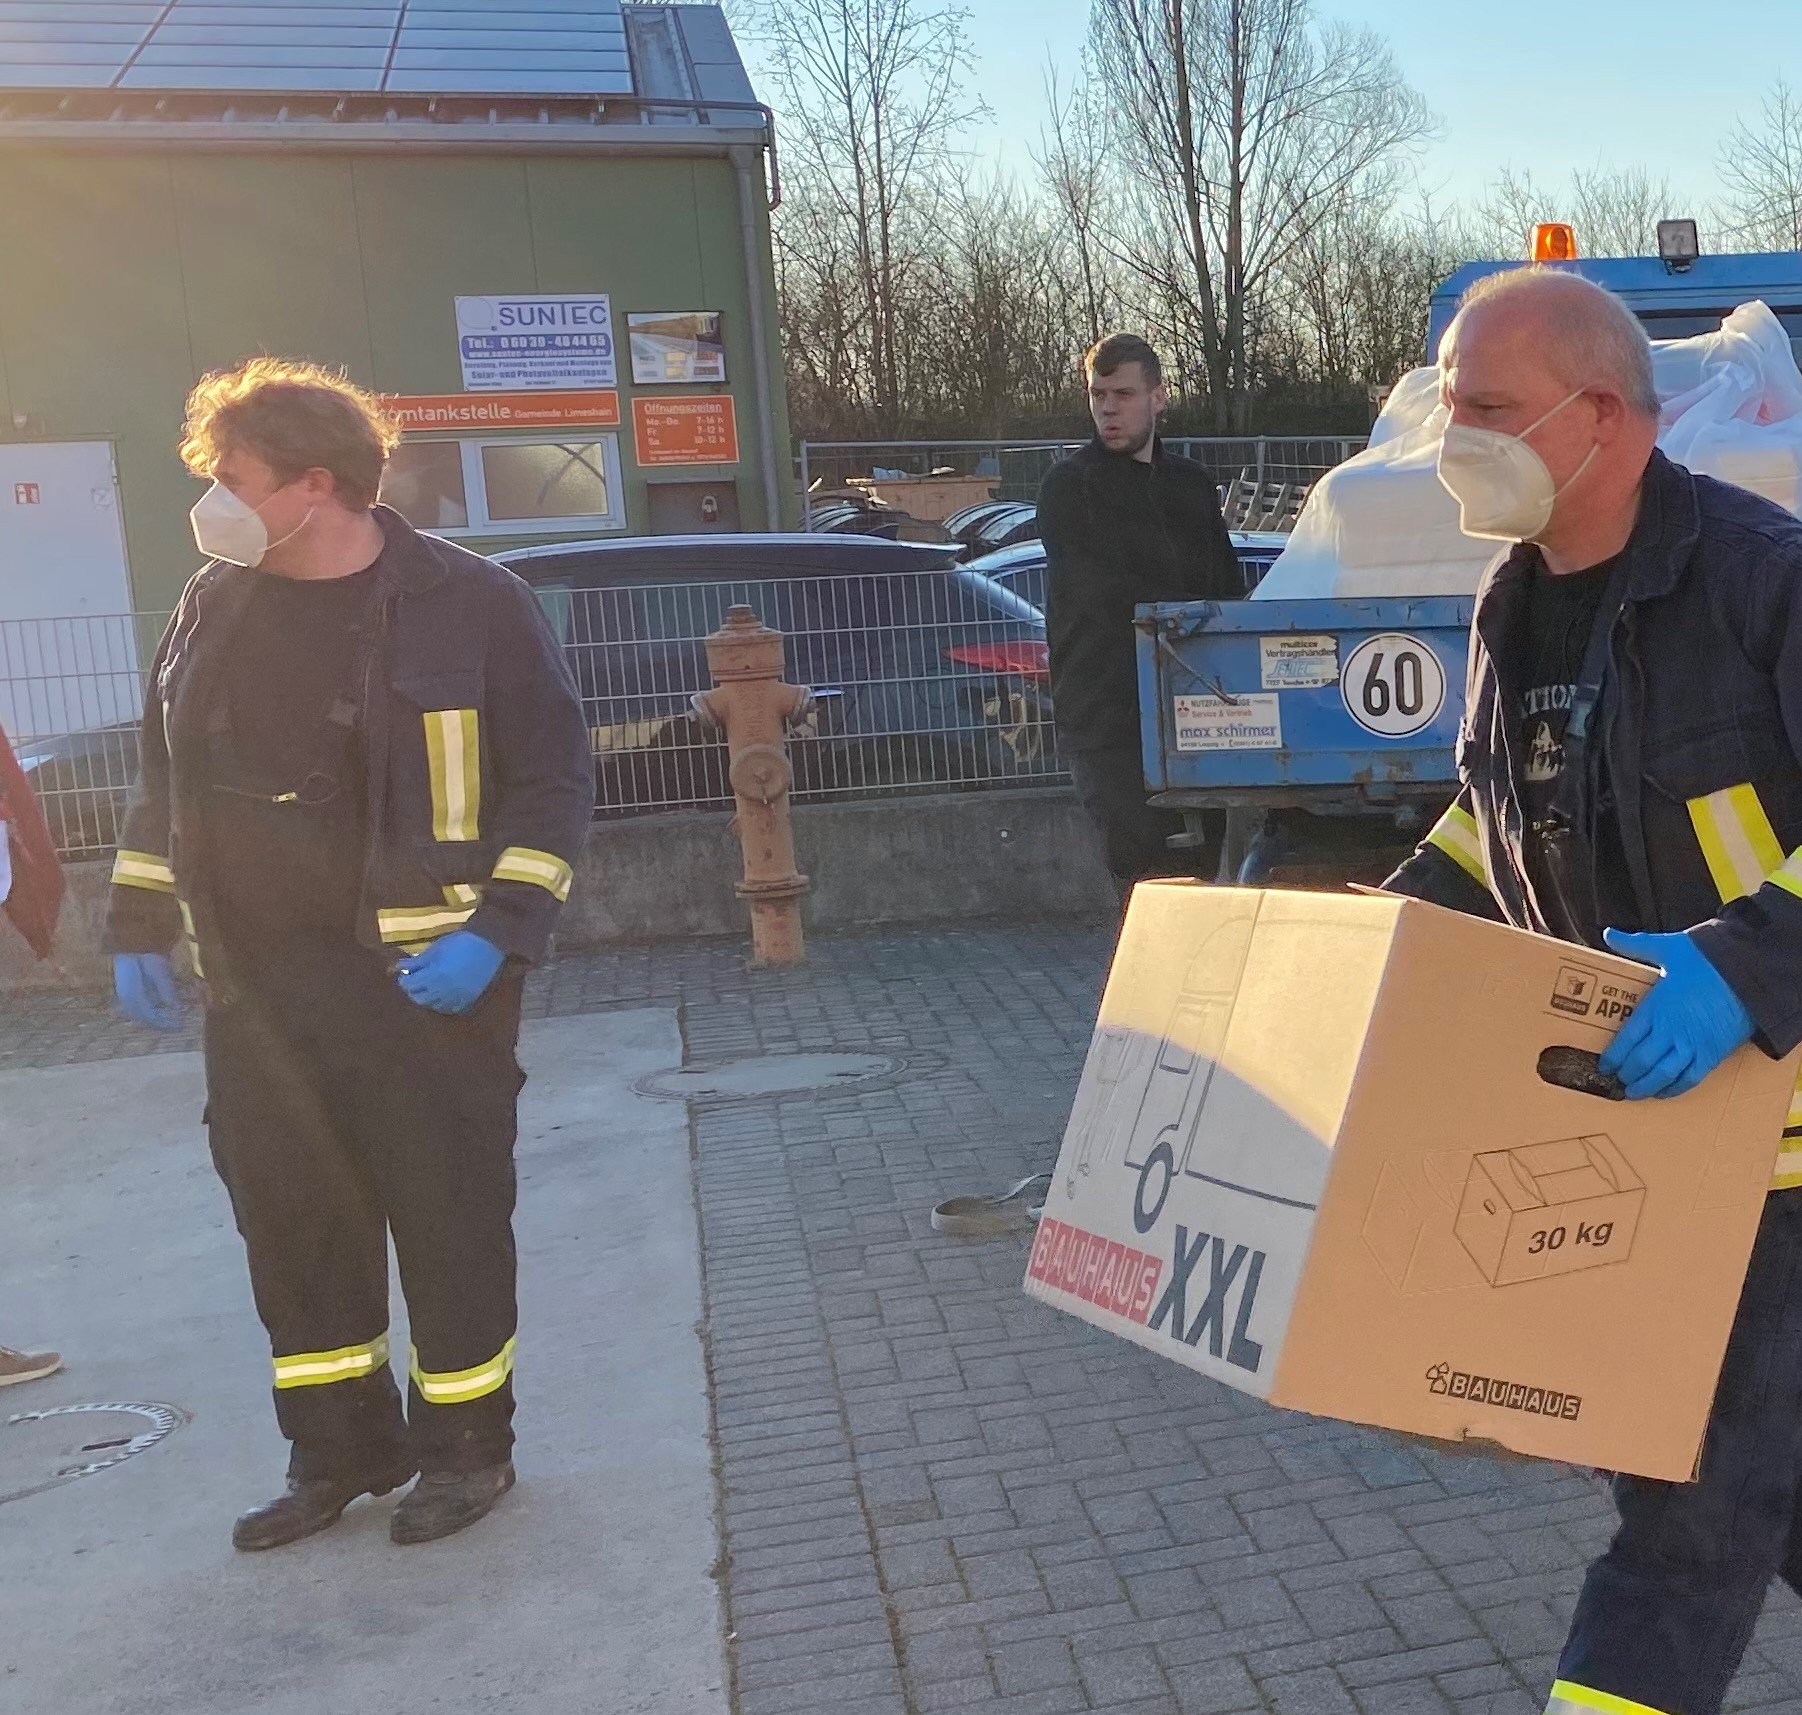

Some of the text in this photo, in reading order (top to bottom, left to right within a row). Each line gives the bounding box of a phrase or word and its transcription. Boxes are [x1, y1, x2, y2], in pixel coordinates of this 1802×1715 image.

[499, 302, 607, 326] SUNTEC
[387, 403, 511, 422] omtankstelle
[1362, 651, 1424, 717] 60
[1180, 723, 1277, 739] max schirmer
[1602, 985, 1639, 1003] GET THE
[1595, 998, 1634, 1022] APP
[1528, 1221, 1615, 1254] 30 kg
[1032, 1222, 1266, 1373] BAUHAUS XXL
[1450, 1373, 1581, 1418] BAUHAUS
